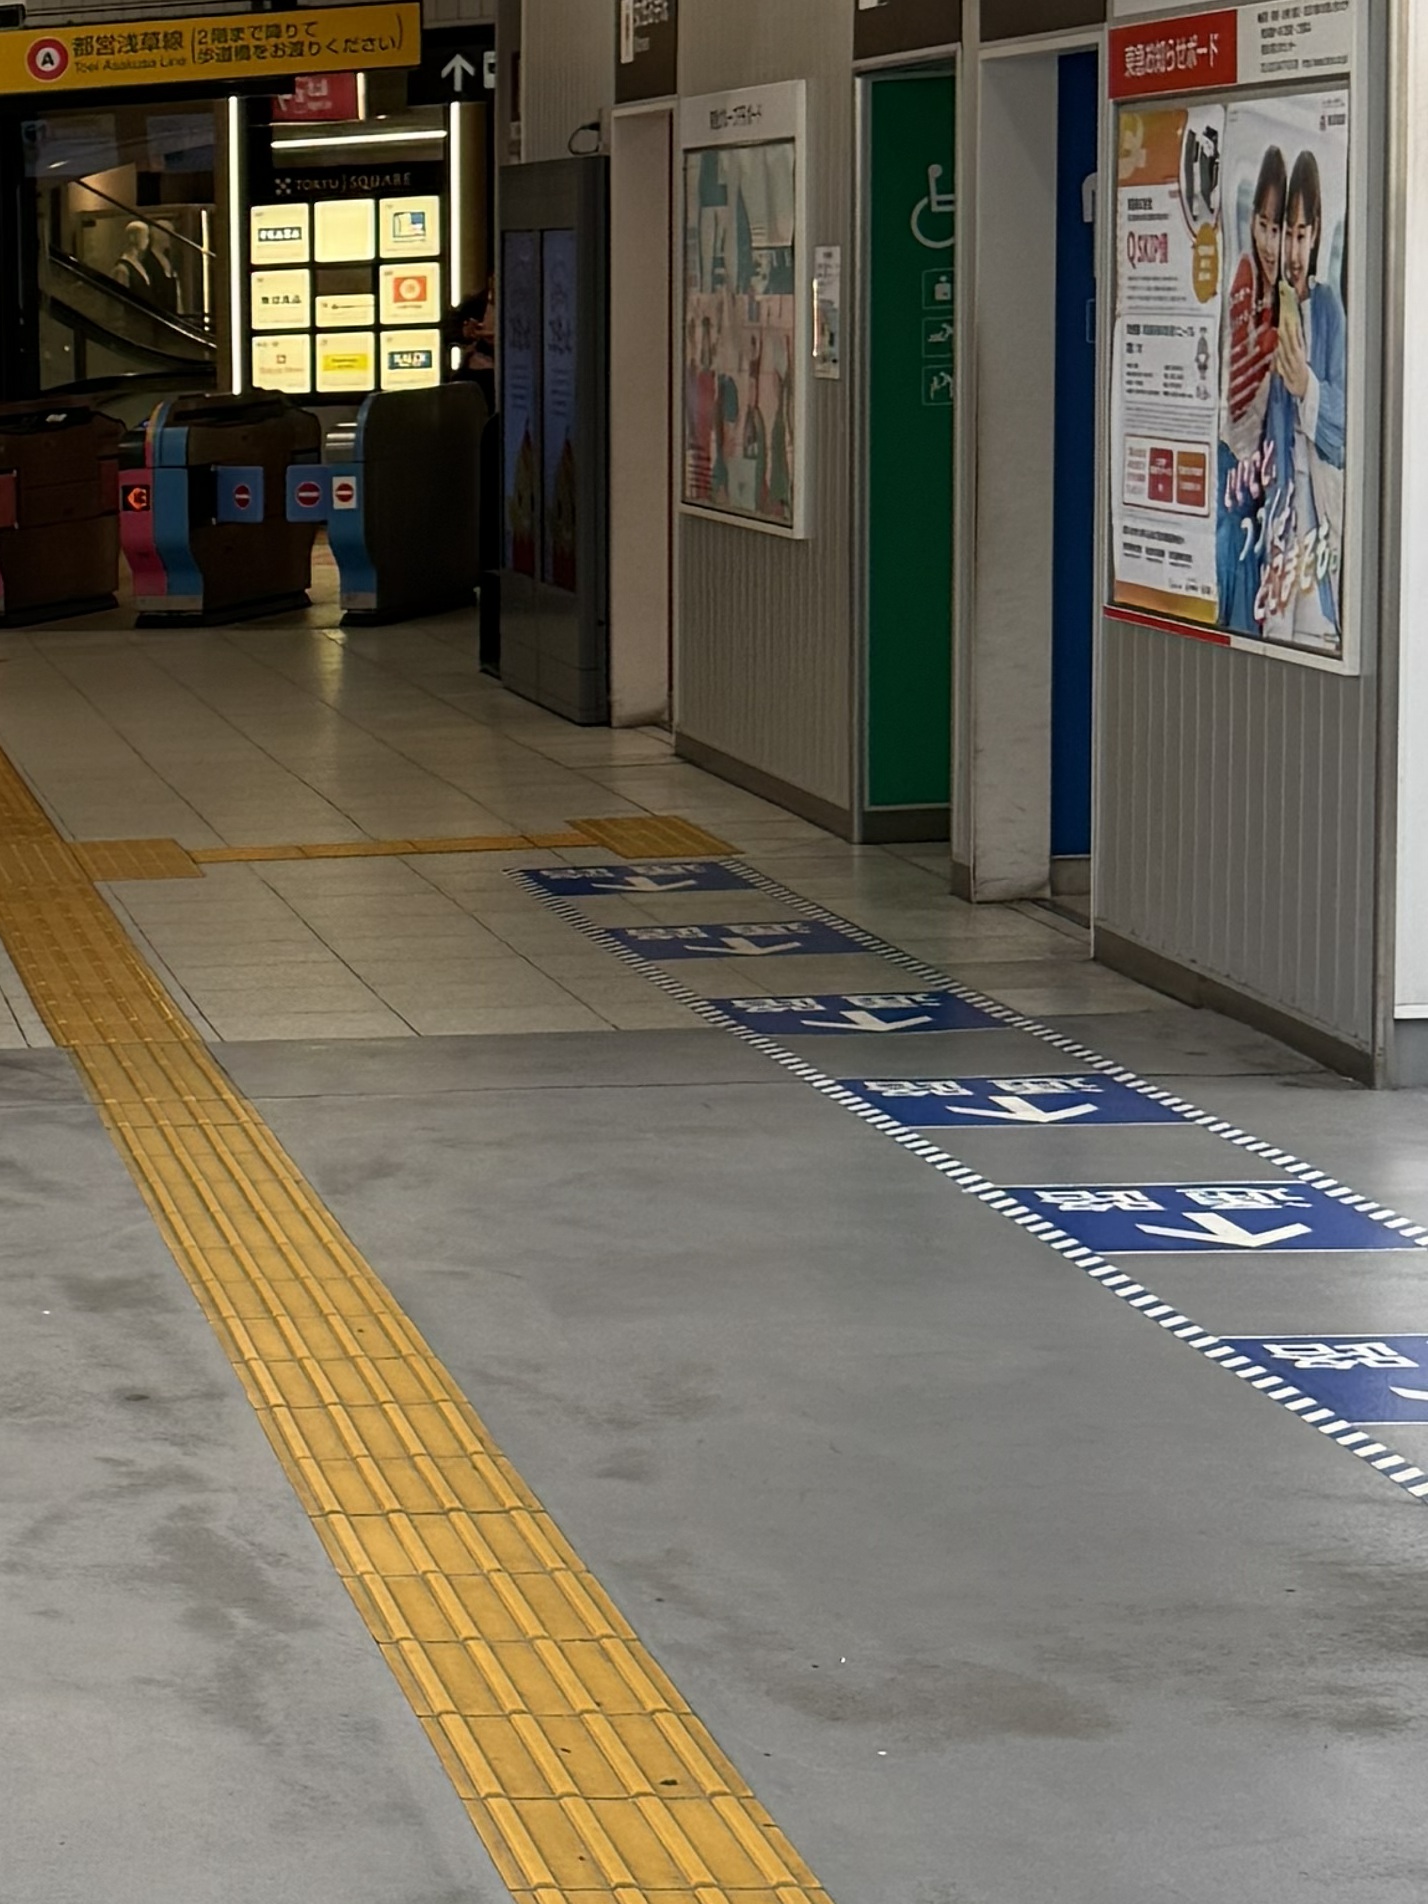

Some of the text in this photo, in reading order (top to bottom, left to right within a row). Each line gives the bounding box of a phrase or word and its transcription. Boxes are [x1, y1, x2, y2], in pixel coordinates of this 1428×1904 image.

[71, 29, 185, 59] 都営浅草線
[40, 51, 55, 68] A
[349, 171, 413, 191] SQUARE
[862, 1077, 1106, 1098] 通路
[1033, 1186, 1314, 1212] 通路
[1261, 1341, 1423, 1370] 路
